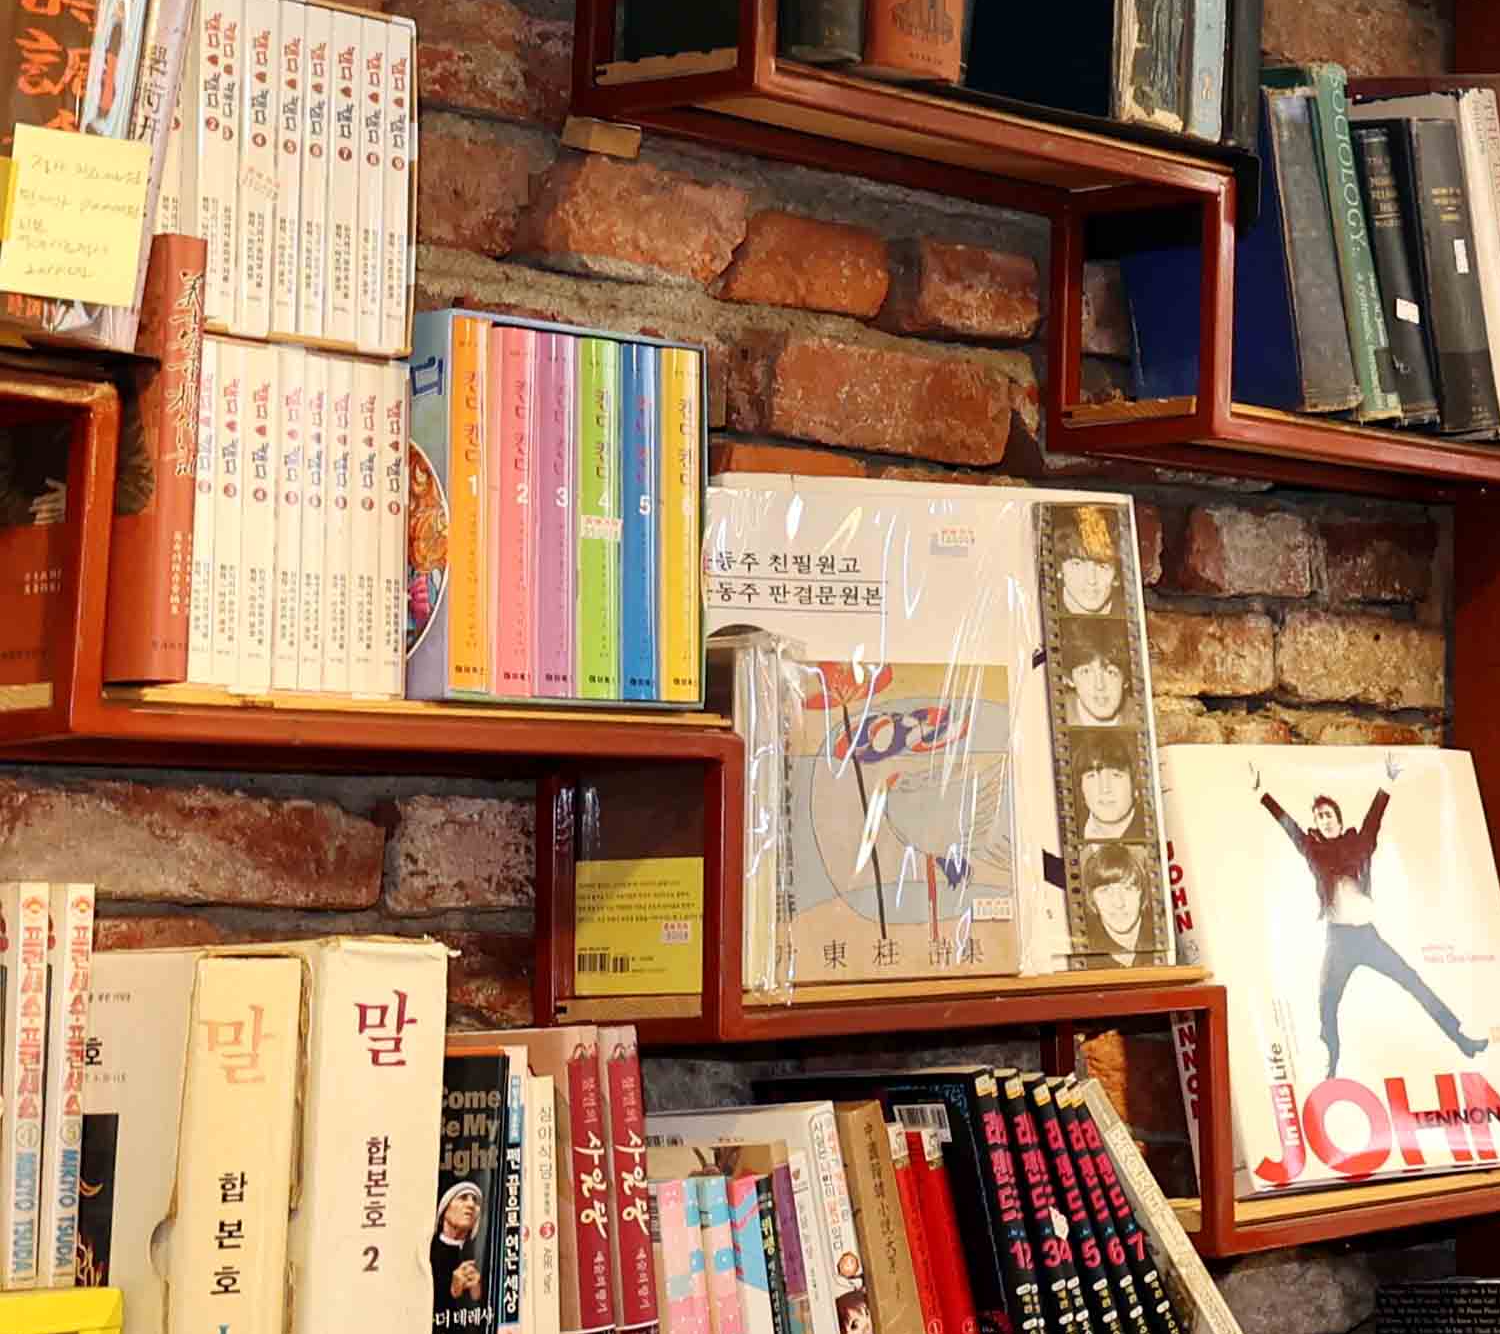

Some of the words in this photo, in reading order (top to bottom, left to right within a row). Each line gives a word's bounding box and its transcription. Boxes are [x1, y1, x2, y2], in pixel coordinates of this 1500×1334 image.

[515, 484, 529, 504] 2
[554, 485, 569, 508] 3
[597, 487, 611, 508] 4
[638, 494, 652, 516] 5
[766, 553, 863, 576] 친필원고
[768, 582, 885, 608] 판결문원본
[1164, 839, 1195, 935] JOHN
[354, 989, 419, 1068] 말
[201, 1003, 280, 1087] 말
[1267, 1040, 1283, 1081] Life
[462, 1113, 500, 1143] My
[359, 1135, 392, 1230] 합본호
[208, 1169, 250, 1297] 합본호
[1127, 1231, 1147, 1261] 7
[361, 1245, 380, 1273] 2
[1081, 1238, 1101, 1268] 5
[1106, 1236, 1126, 1267] 6
